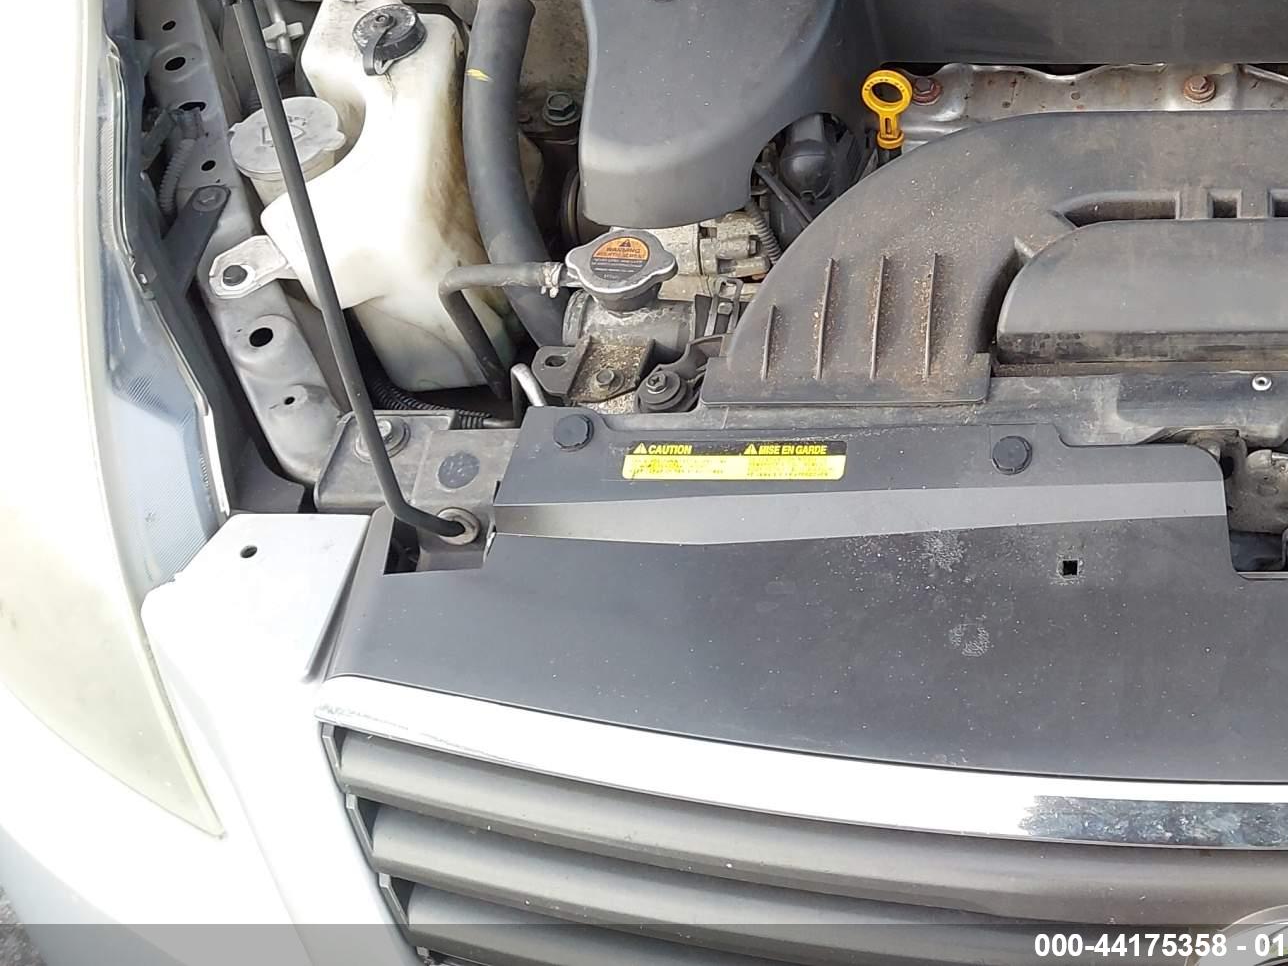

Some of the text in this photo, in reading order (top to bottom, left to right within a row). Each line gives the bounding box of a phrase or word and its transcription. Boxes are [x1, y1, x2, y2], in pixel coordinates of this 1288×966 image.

[647, 444, 693, 455] CAUTION
[758, 445, 828, 455] MISE EN GARDE
